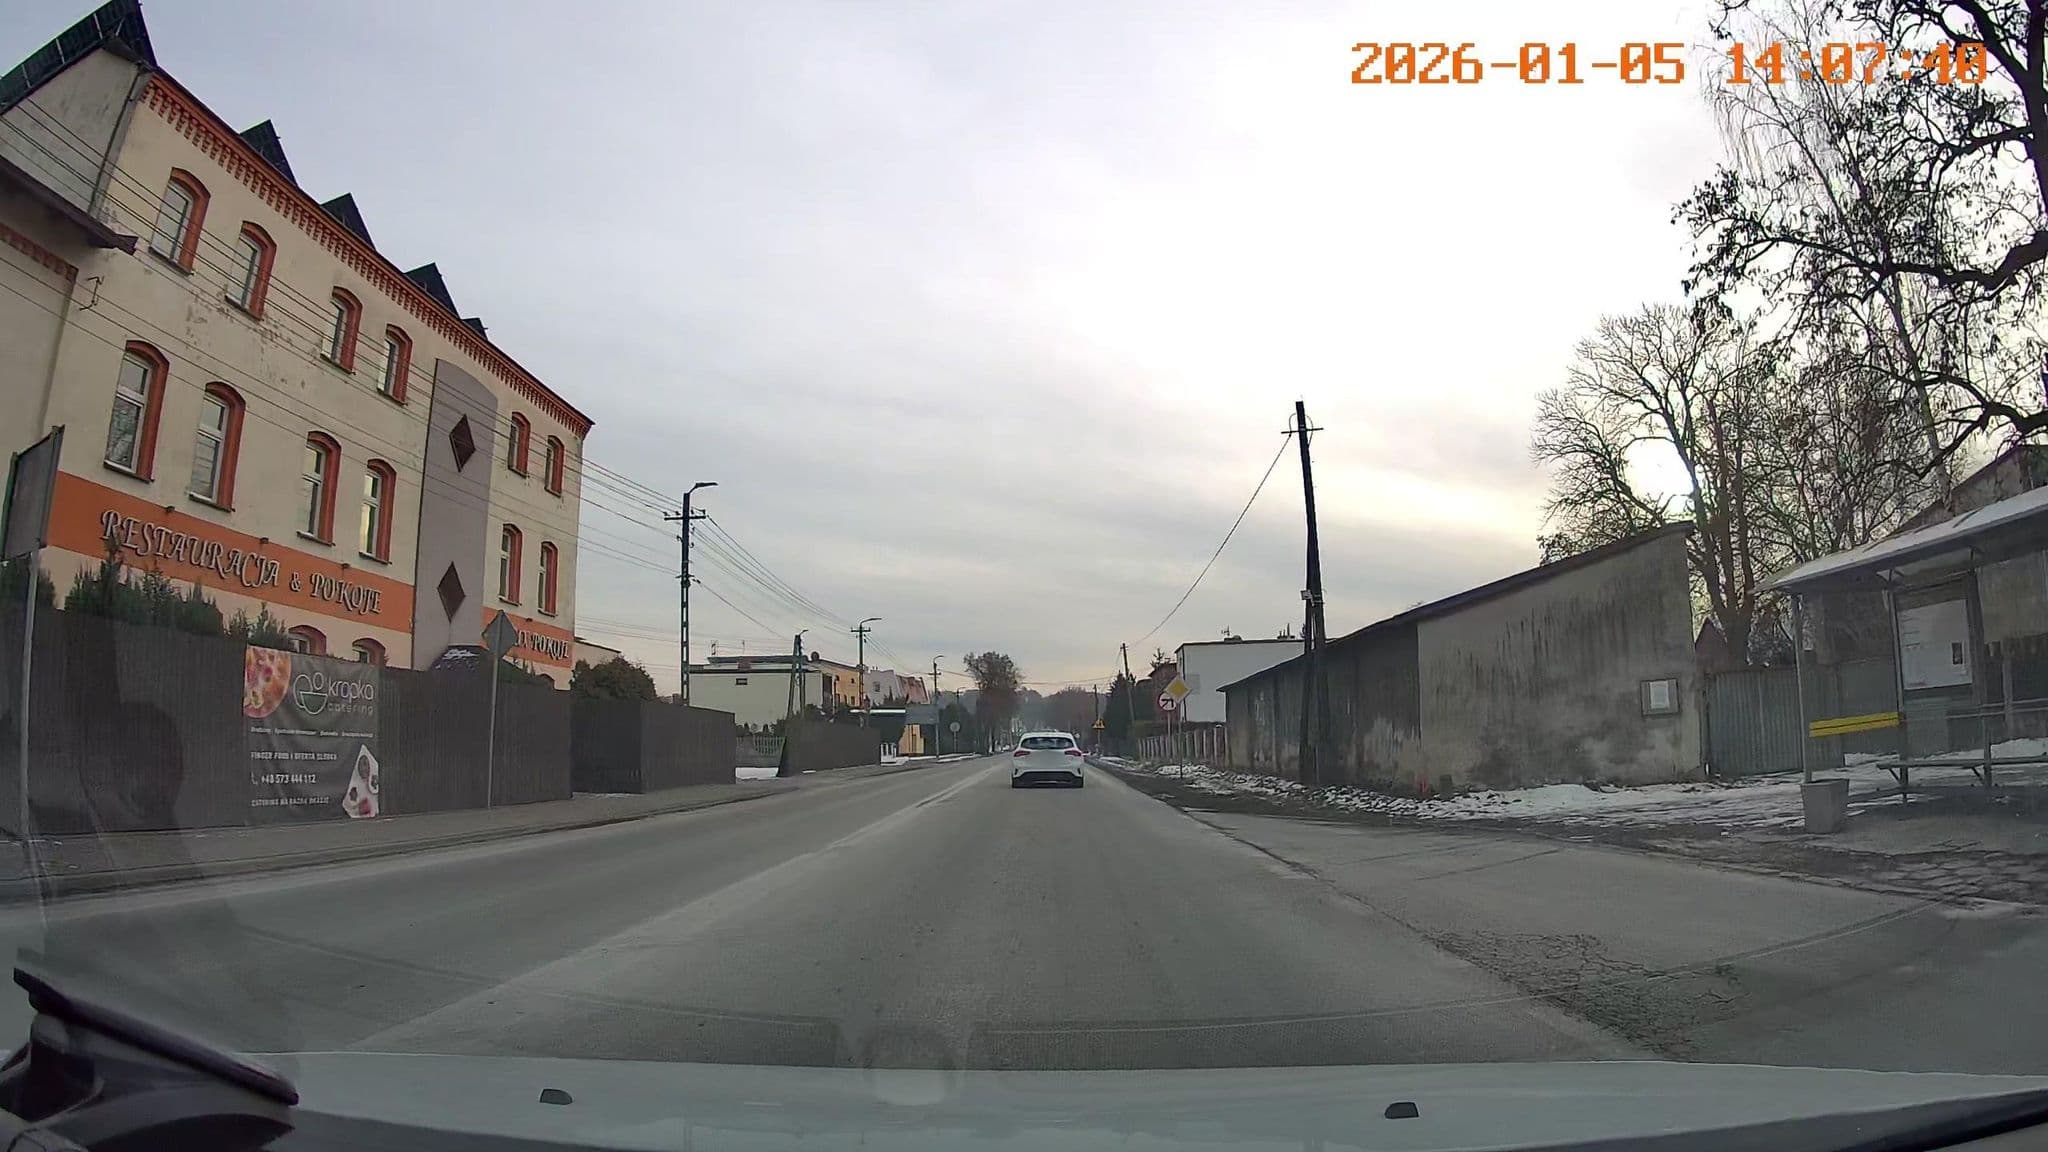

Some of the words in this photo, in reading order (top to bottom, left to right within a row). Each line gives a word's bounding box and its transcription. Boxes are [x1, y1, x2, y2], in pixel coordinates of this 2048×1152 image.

[100, 509, 281, 588] RESTAURACJA
[290, 572, 302, 593] &
[310, 572, 382, 615] POKOJE
[275, 774, 289, 783] 573
[304, 774, 317, 783] 112
